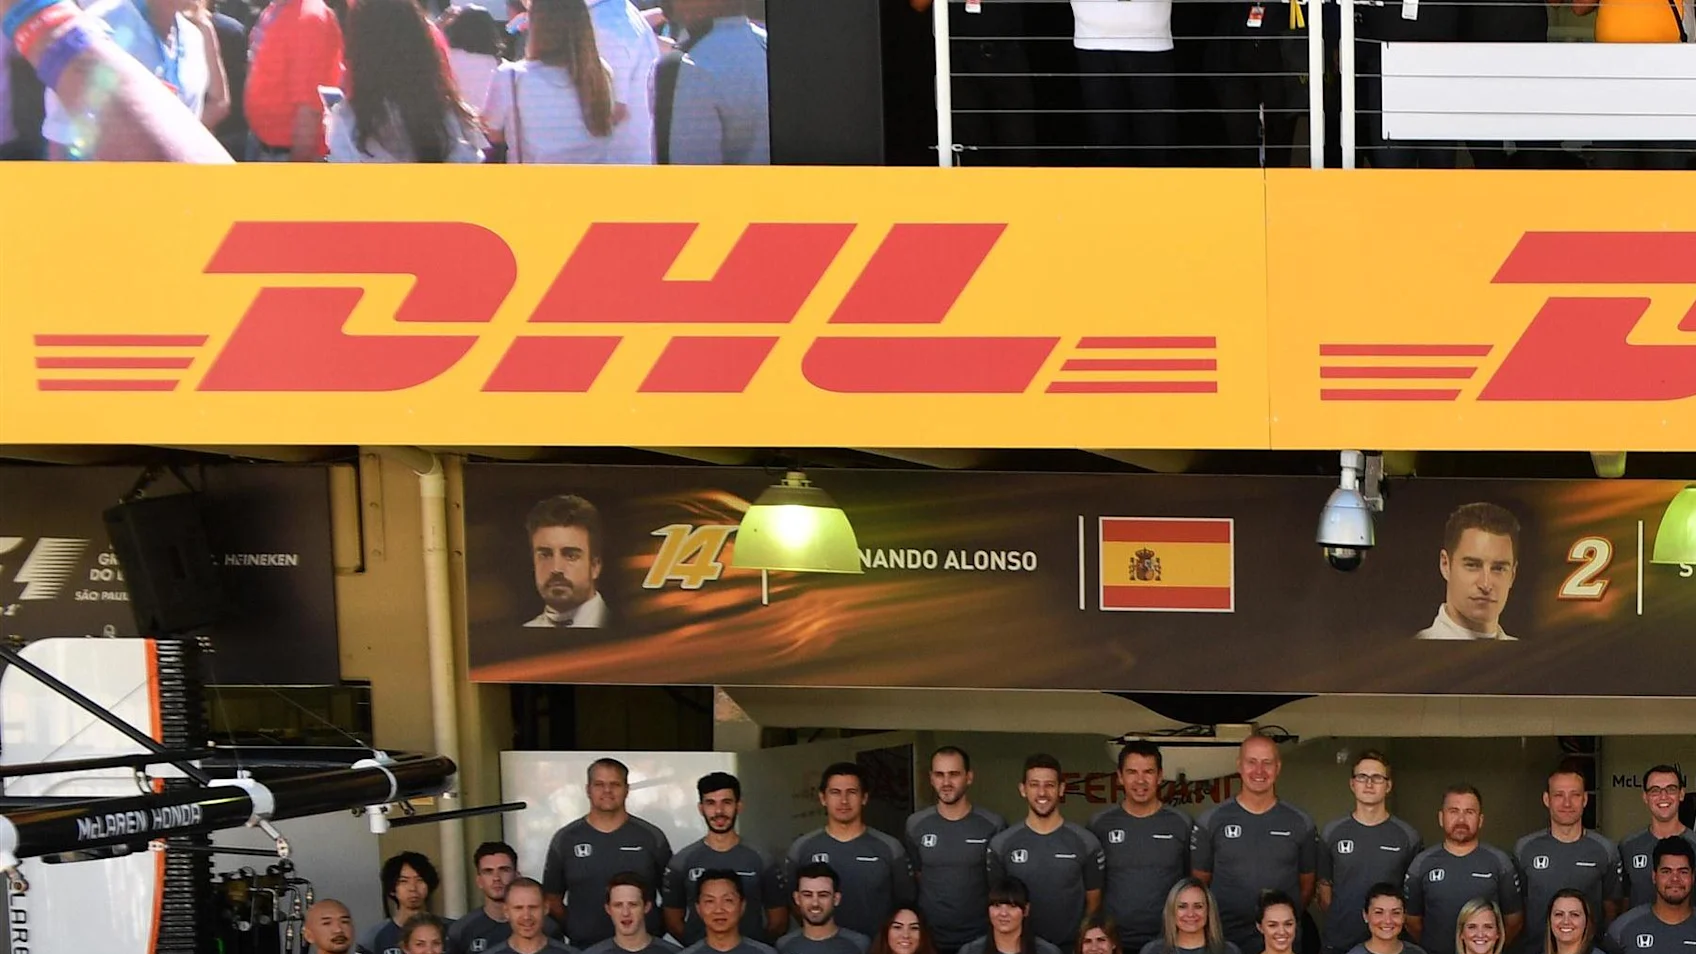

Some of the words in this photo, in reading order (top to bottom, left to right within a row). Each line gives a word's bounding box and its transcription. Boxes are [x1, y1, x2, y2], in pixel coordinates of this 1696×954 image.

[195, 222, 1061, 393] DHL
[89, 568, 115, 581] DO
[642, 524, 738, 590] 14
[858, 547, 938, 570] NANDO
[943, 550, 1038, 572] ALONSO
[1557, 536, 1613, 600] 2
[101, 591, 130, 601] PAUL
[76, 810, 148, 840] McLAREN
[151, 803, 202, 830] HONDA
